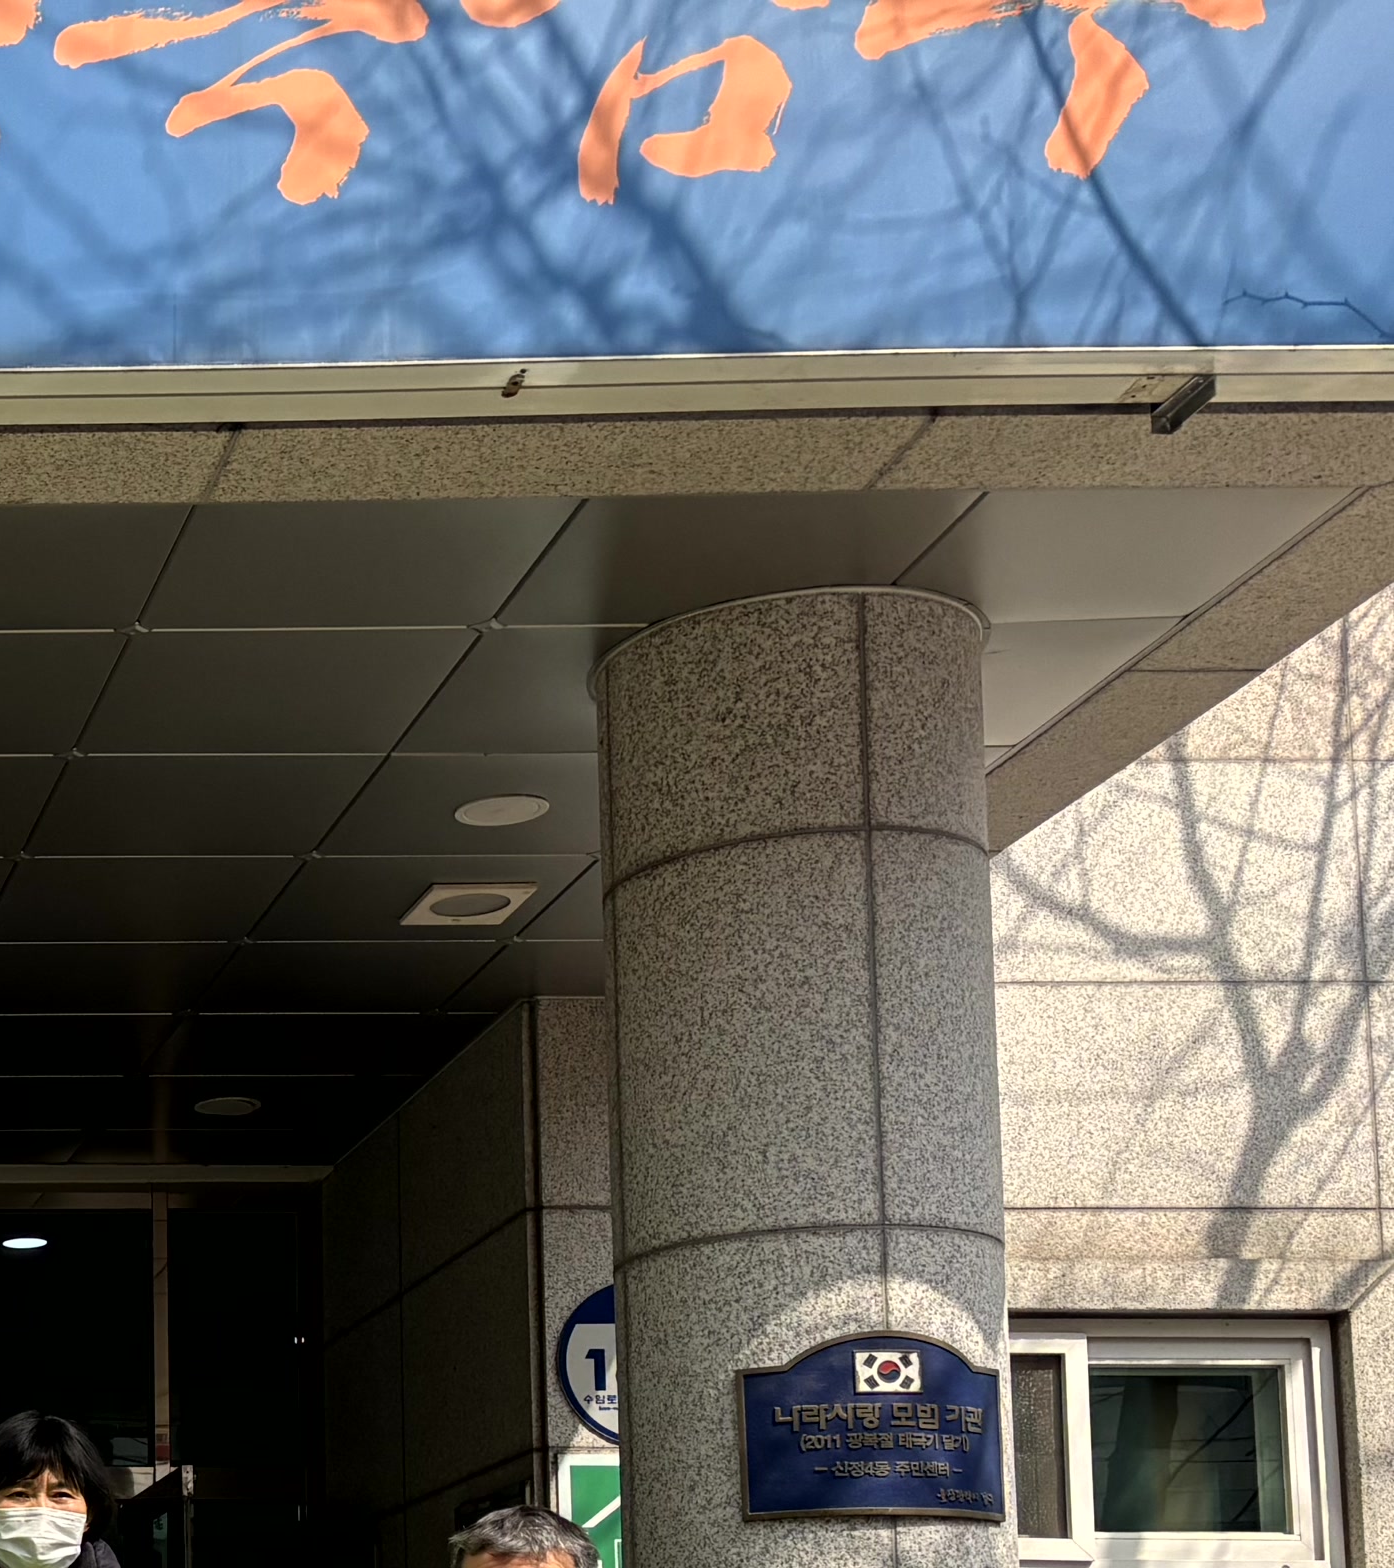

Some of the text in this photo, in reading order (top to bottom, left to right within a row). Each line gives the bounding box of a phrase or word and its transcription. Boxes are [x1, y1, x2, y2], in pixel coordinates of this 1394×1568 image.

[774, 1402, 984, 1434] 나라사랑 모범 기관
[800, 1433, 842, 1452] (2011
[845, 1432, 894, 1450] 광복절
[898, 1432, 940, 1451] 태극기
[832, 1461, 951, 1478] 신정4동 주민센터
